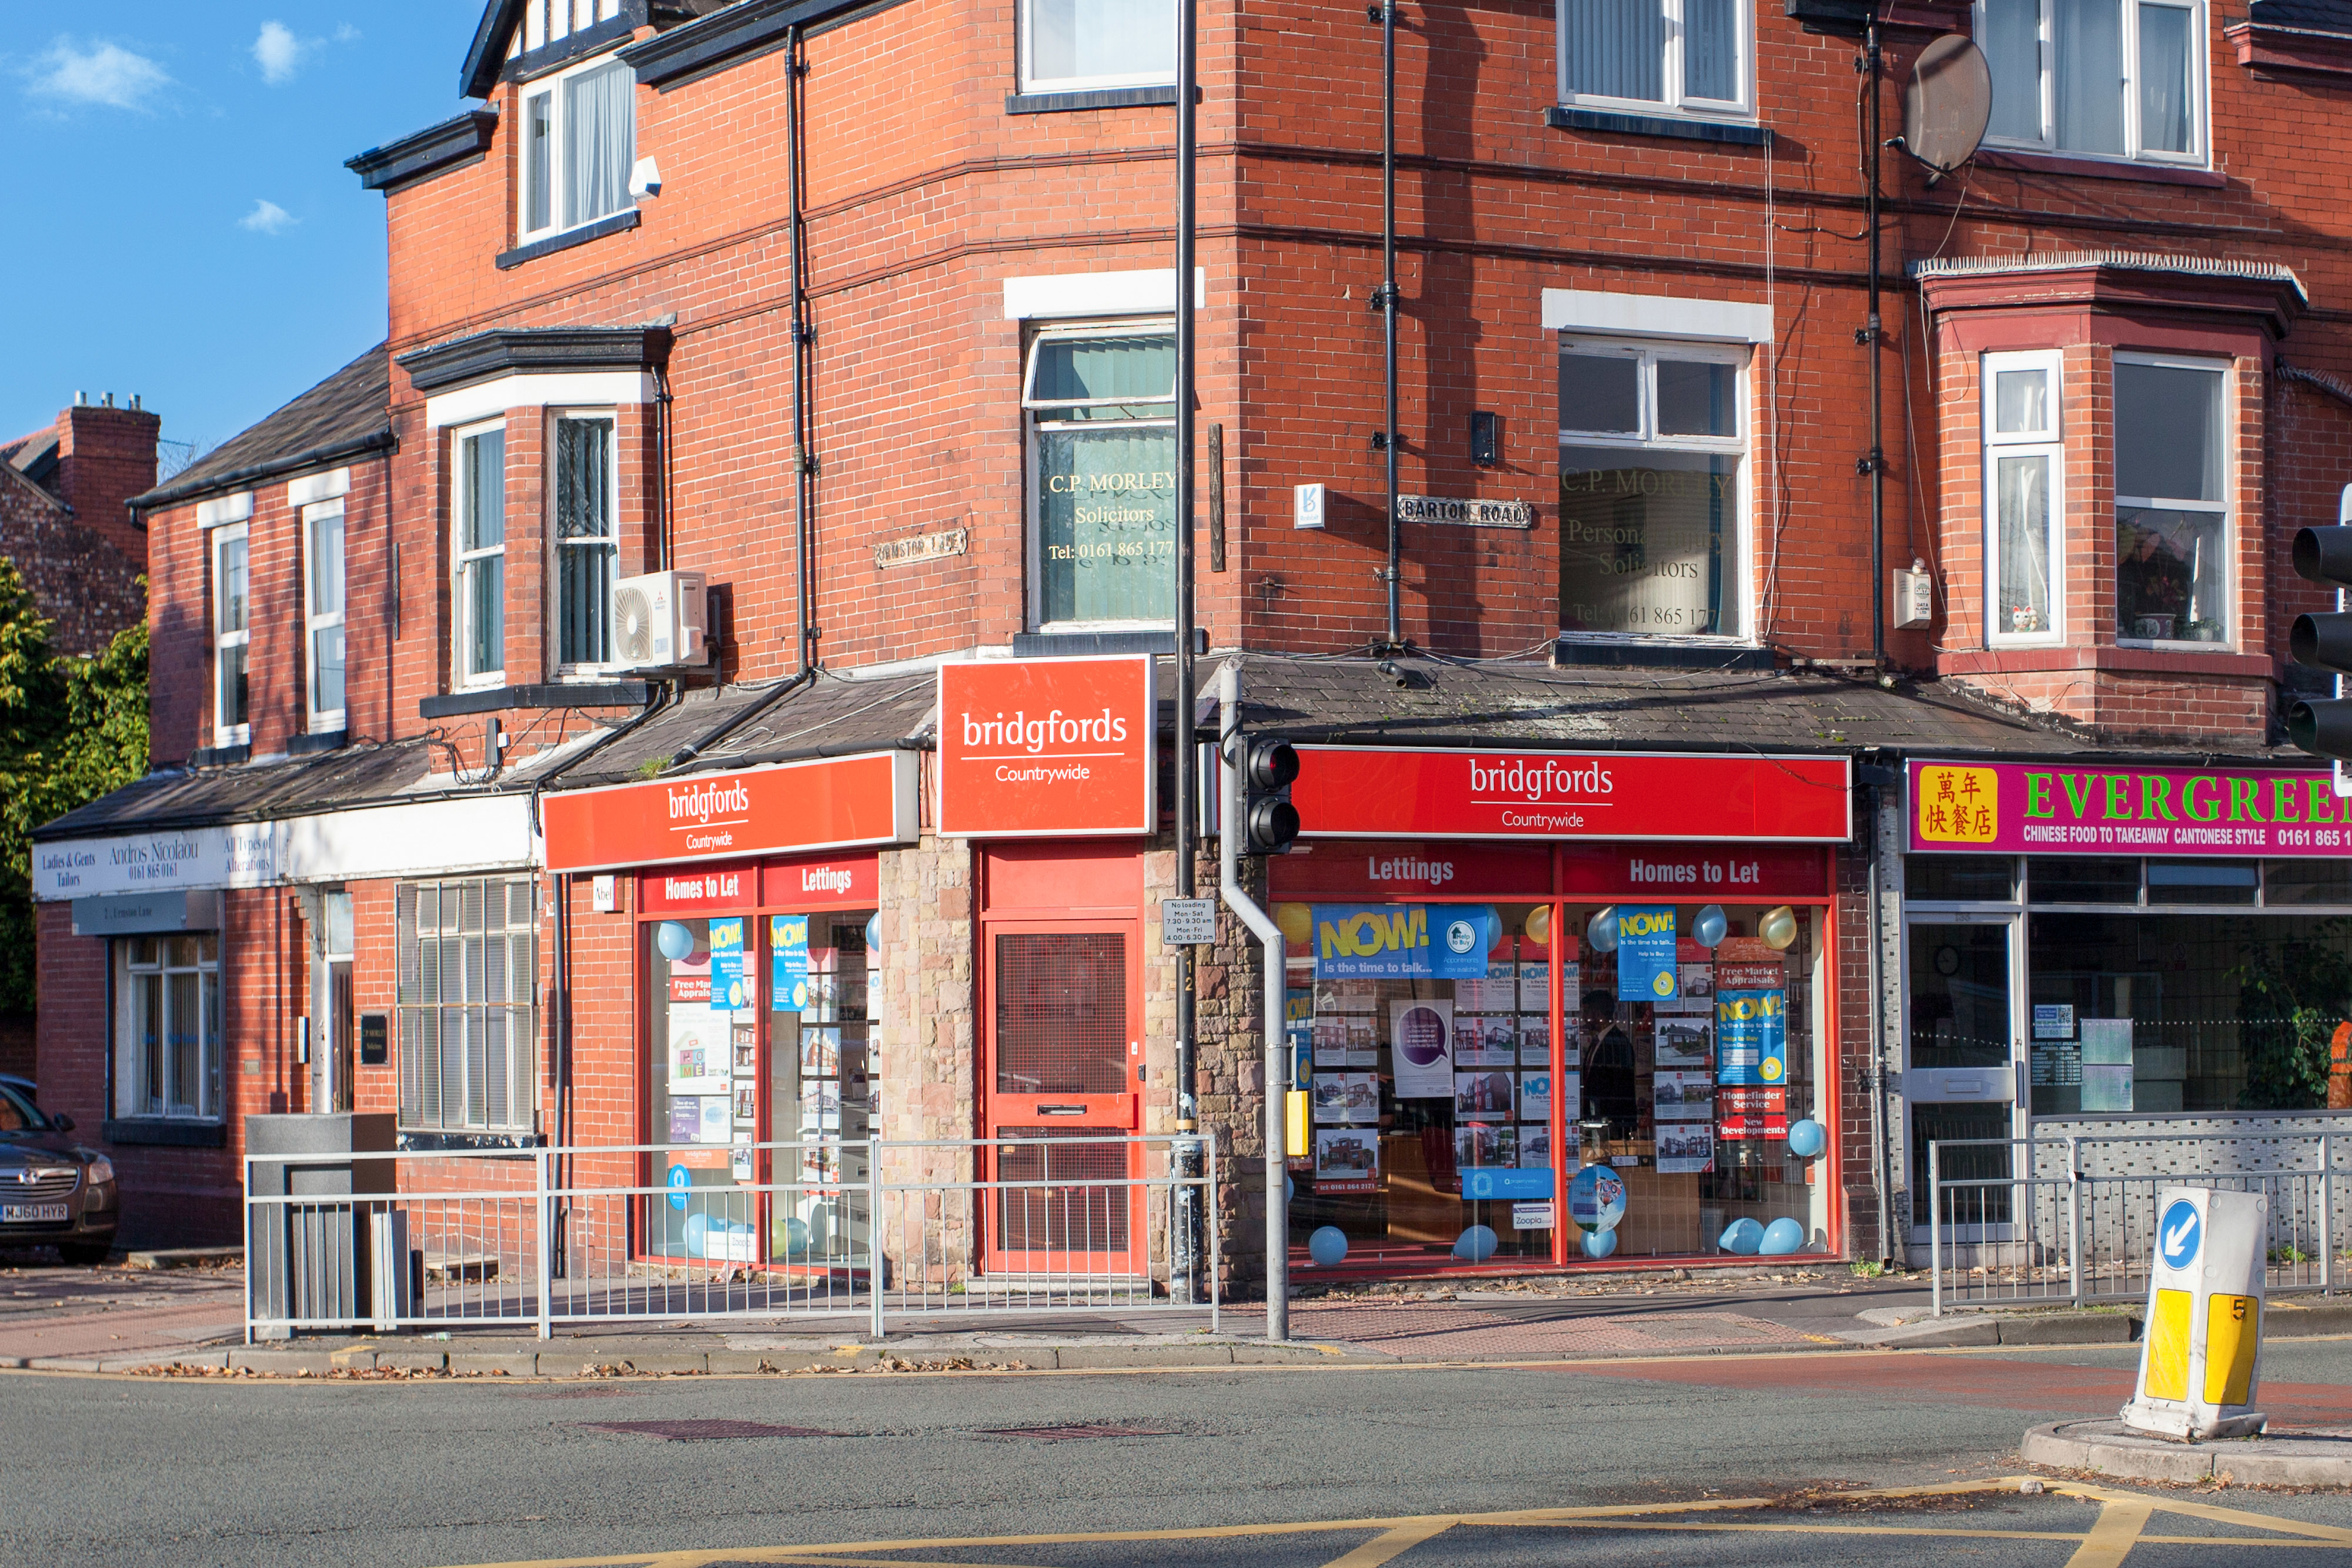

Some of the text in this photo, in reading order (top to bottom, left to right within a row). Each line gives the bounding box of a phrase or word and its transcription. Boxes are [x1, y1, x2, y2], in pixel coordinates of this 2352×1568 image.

[1050, 472, 1176, 493] C.P. MORLEY
[1562, 467, 1606, 492] C.P.
[1075, 506, 1154, 523] Solicitors
[1405, 501, 1524, 522] BARTON ROAD
[1568, 520, 1655, 544] Persona
[1049, 544, 1075, 560] Tel:
[1079, 543, 1112, 558] 0161
[1118, 541, 1143, 556] 865
[1599, 552, 1698, 579] Solicitors
[1655, 607, 1682, 624] 865
[961, 708, 1127, 753] bridgfords
[995, 763, 1090, 785] Countrywide
[1469, 758, 1613, 801] bridgfords
[1937, 771, 1981, 804] 萬年
[2024, 772, 2352, 823] EVERGREE
[668, 779, 749, 823] bridgfords
[1502, 810, 1584, 831] Countrywide
[1926, 803, 1992, 837] 快餐店
[224, 833, 272, 854] All Types of
[686, 831, 732, 851] Countrywide
[2024, 825, 2067, 842] CHINESE
[2070, 826, 2097, 842] FOOD
[2100, 827, 2113, 843] TO
[2116, 827, 2169, 844] TAKEAWAY
[2174, 828, 2233, 845] CANTONESE
[2235, 828, 2266, 845] STYLE
[2278, 829, 2310, 845] 0161
[2315, 830, 2340, 846] 865
[42, 851, 95, 870] Ladies & Gents
[109, 839, 198, 865] Andros Nicolaou
[129, 862, 177, 880] 0161 865 0161
[225, 855, 269, 873] Alterations
[1369, 855, 1454, 885] Lettings
[1630, 860, 1759, 883] Homes to Let
[57, 871, 80, 887] Tailors
[665, 874, 739, 901] Homes to Let
[802, 867, 851, 894] Lettings
[596, 885, 612, 901] Abel
[773, 922, 807, 948] NOW!
[1319, 909, 1429, 959] NOW!
[1619, 911, 1675, 938] NOW!
[709, 922, 742, 950] NOW!
[1186, 959, 1191, 974] 1
[1325, 962, 1432, 973] is the time to talk...
[1745, 967, 1779, 975] Market
[674, 980, 694, 989] Free
[1185, 977, 1193, 991] 2
[1725, 975, 1776, 985] Appraisals
[1719, 995, 1783, 1022] NOW!
[1722, 1091, 1781, 1100] Homefinder
[1733, 1100, 1770, 1108] Service
[1721, 1126, 1786, 1135] Developments
[6, 1205, 66, 1219] MJ60 HYR
[2233, 1299, 2246, 1320] 5
